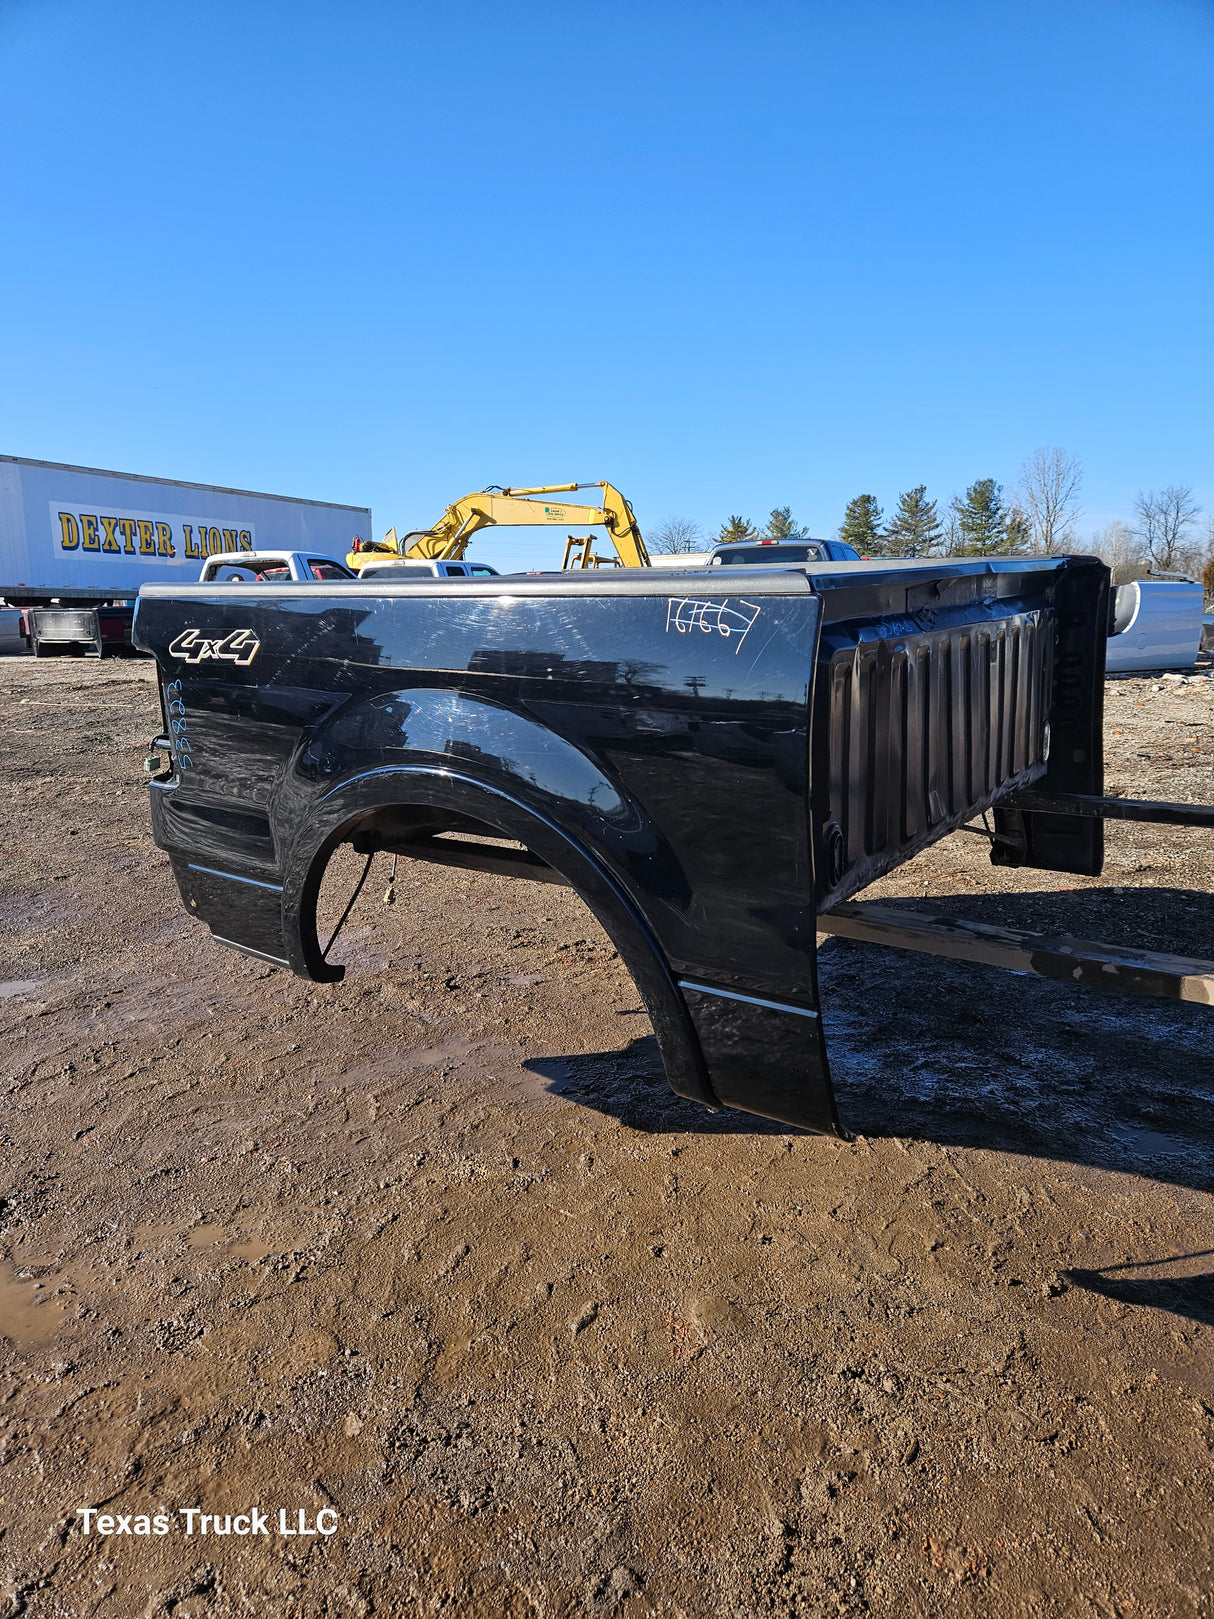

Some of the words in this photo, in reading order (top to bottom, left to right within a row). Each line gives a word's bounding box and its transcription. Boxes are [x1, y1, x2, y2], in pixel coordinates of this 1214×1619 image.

[58, 512, 175, 558] DEXTER
[183, 524, 254, 559] LIONS
[167, 678, 194, 770] 53823
